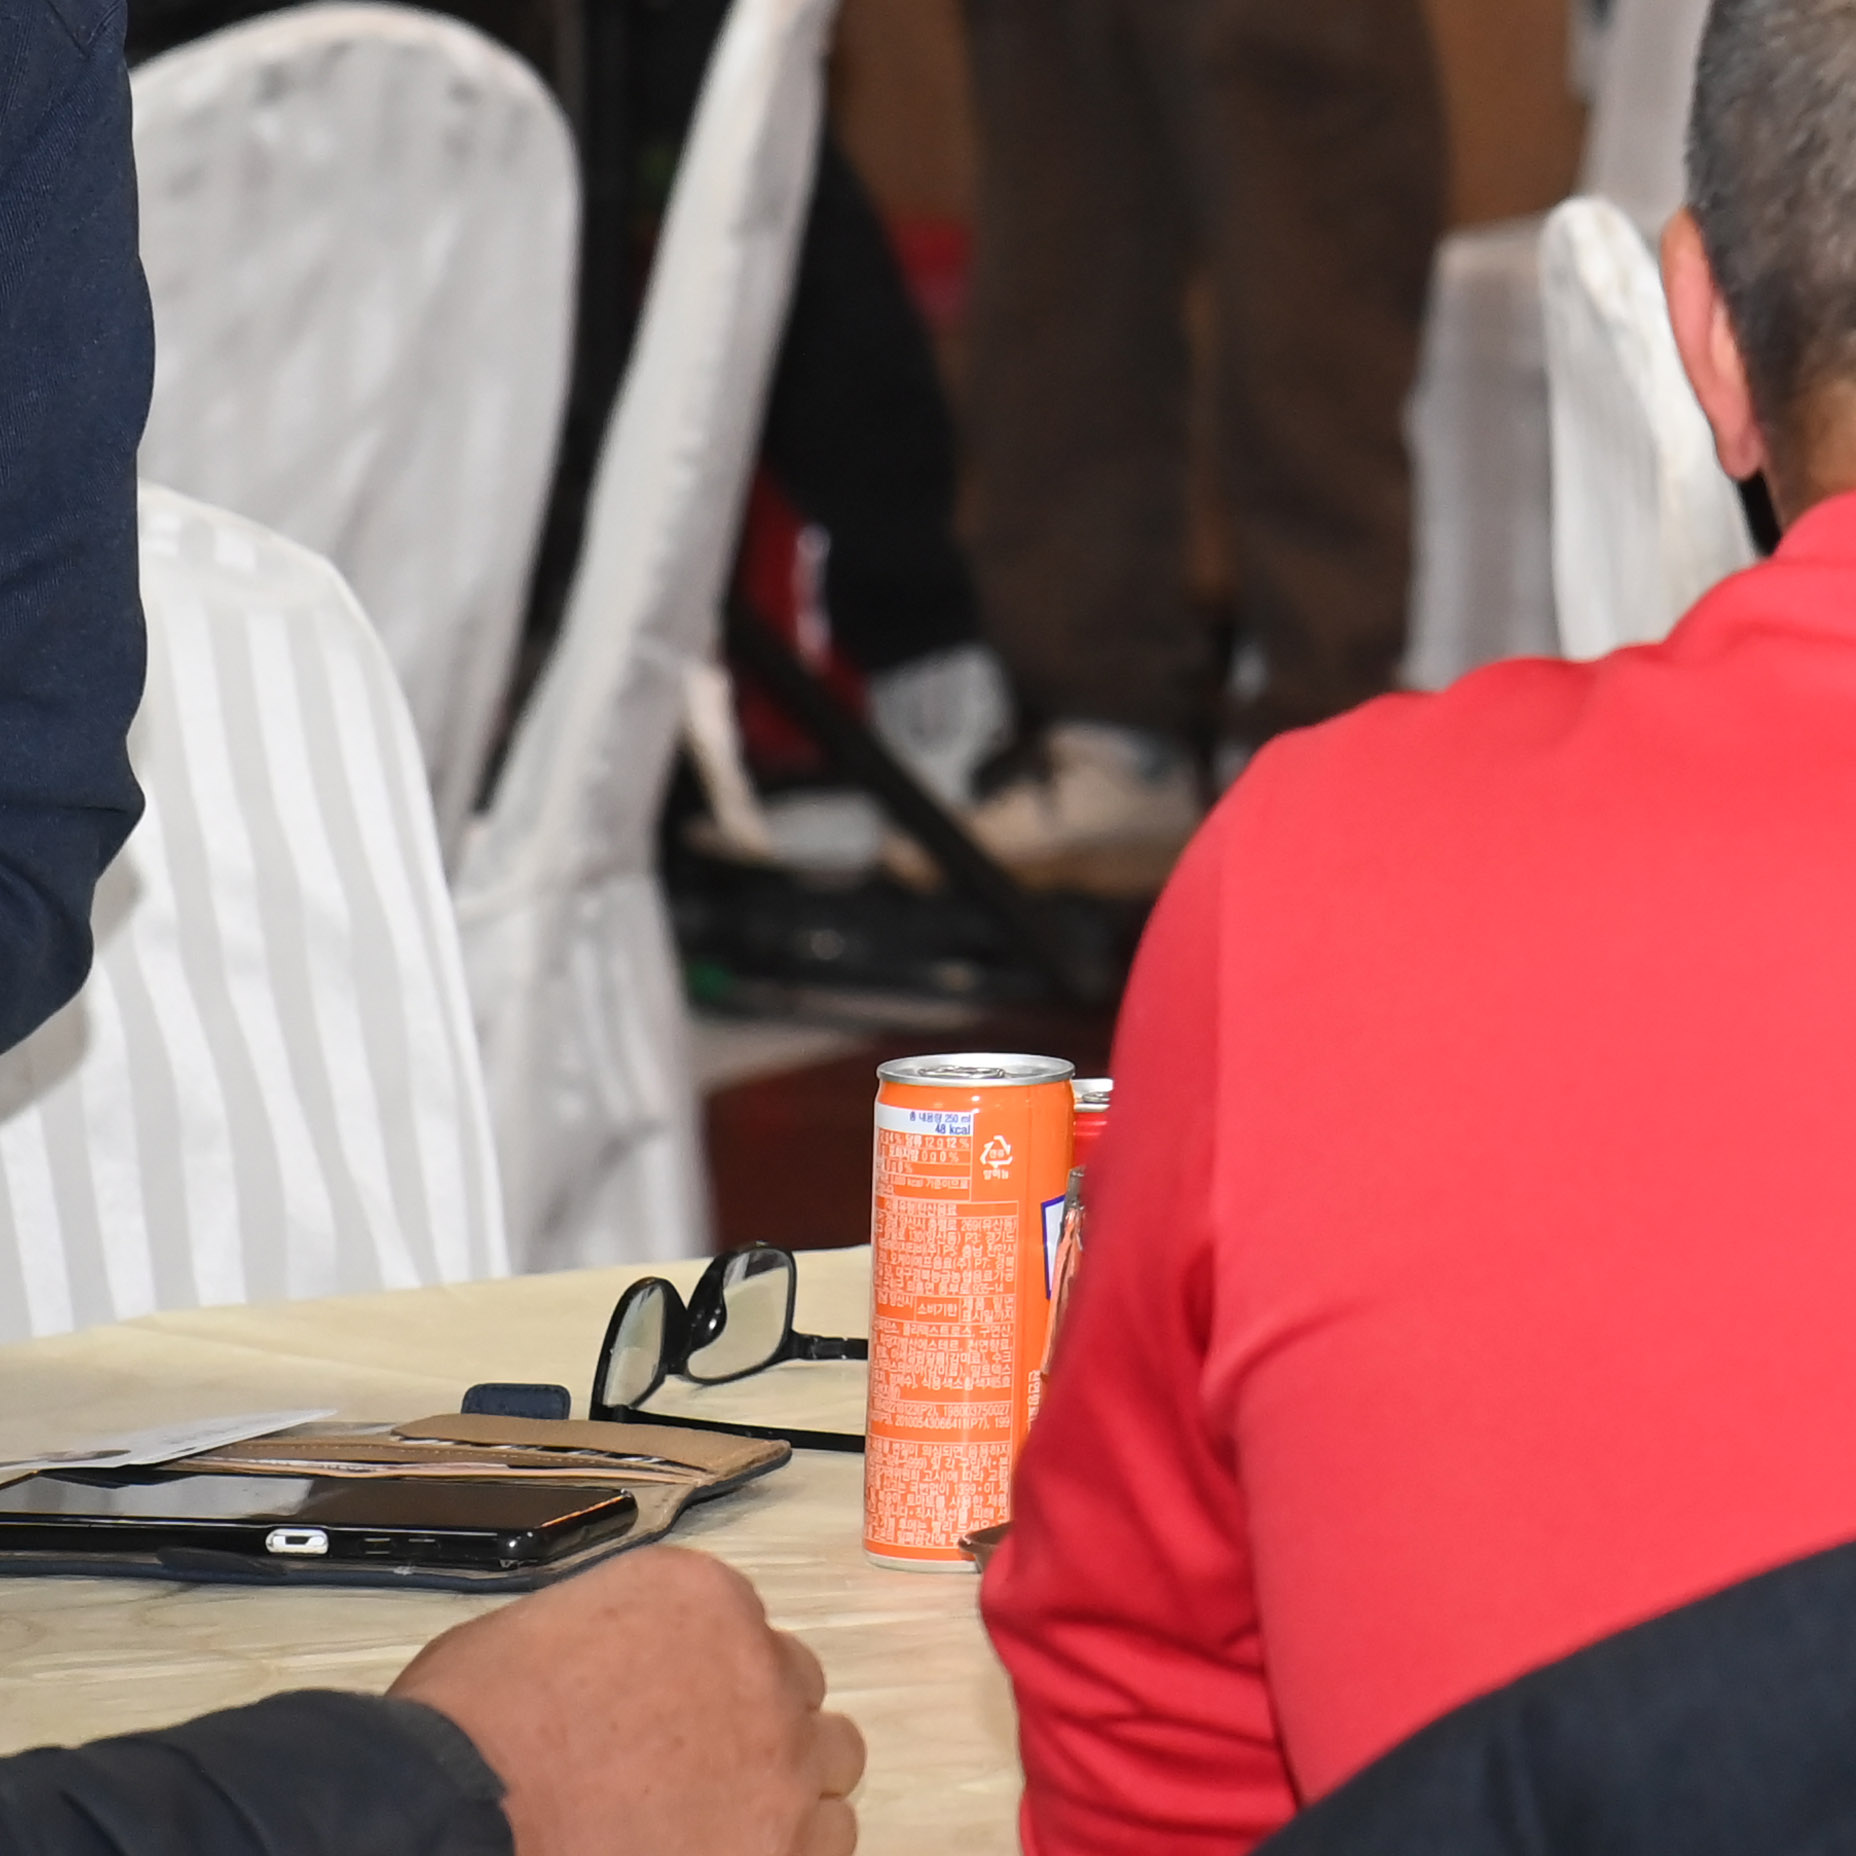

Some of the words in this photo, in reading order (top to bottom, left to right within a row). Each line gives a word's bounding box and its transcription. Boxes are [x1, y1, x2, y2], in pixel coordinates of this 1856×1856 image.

[935, 1124, 946, 1135] 48
[949, 1125, 971, 1136] kcal
[925, 1136, 935, 1149] 12
[946, 1137, 957, 1149] 12
[916, 1302, 958, 1318] 소비기한
